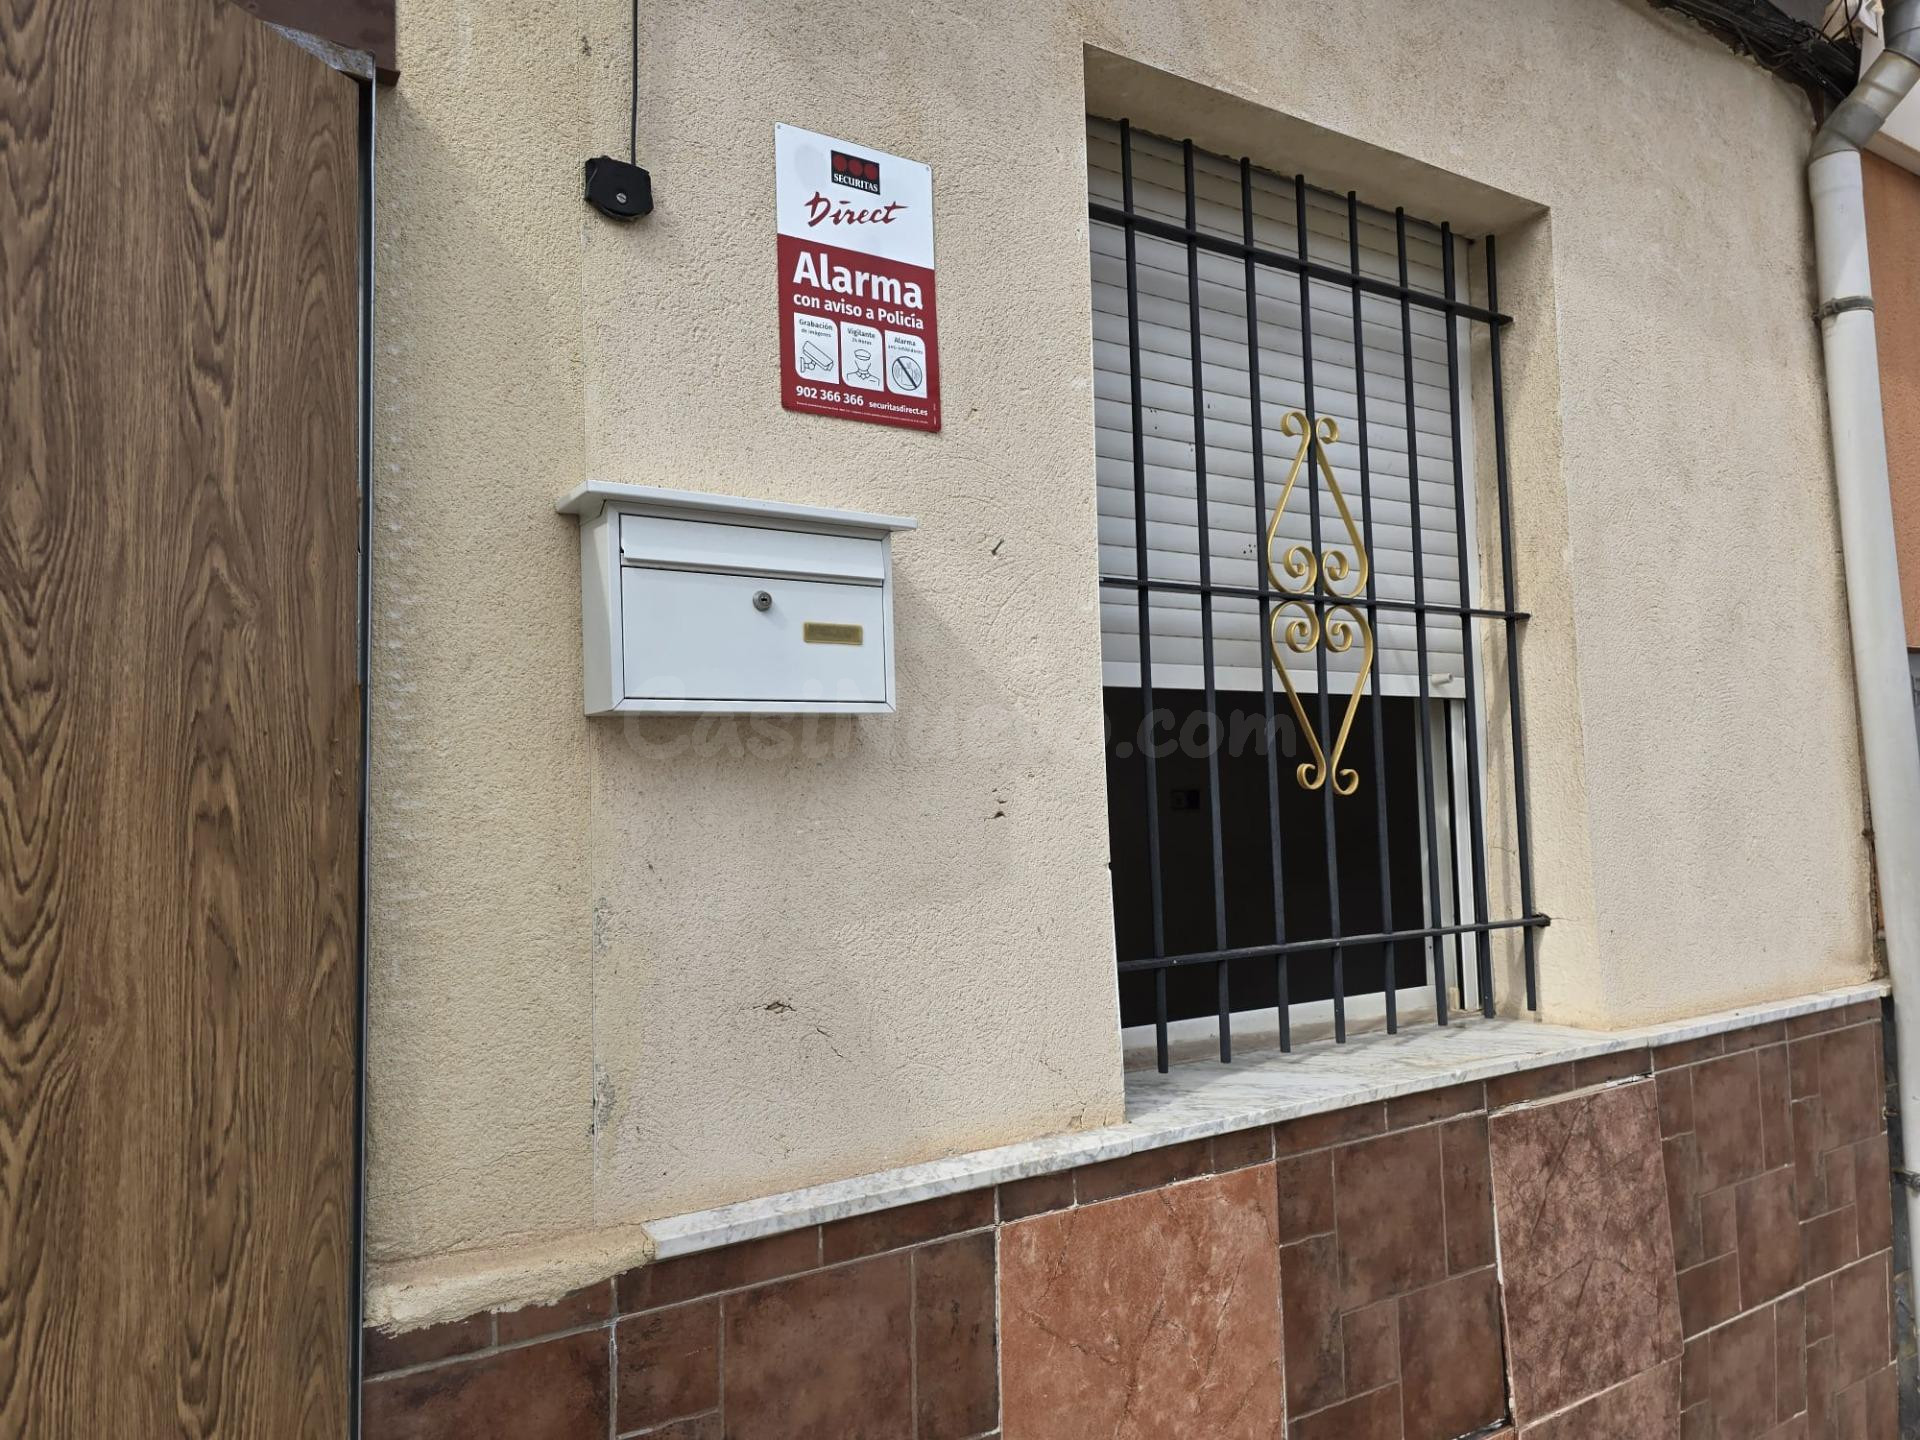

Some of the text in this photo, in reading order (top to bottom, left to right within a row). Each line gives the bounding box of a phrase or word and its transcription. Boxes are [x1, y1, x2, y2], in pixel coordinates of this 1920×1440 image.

[834, 173, 878, 192] SECURITAS
[804, 191, 909, 227] Direct
[793, 251, 923, 310] Alarma
[793, 293, 924, 330] con aviso a Policía
[799, 318, 833, 331] Grabación
[847, 328, 876, 340] Vigilante
[894, 336, 916, 347] Alarma
[796, 385, 818, 399] 902
[820, 388, 841, 402] 366
[843, 392, 864, 406] 366
[869, 400, 928, 416] securitasdirect.es
